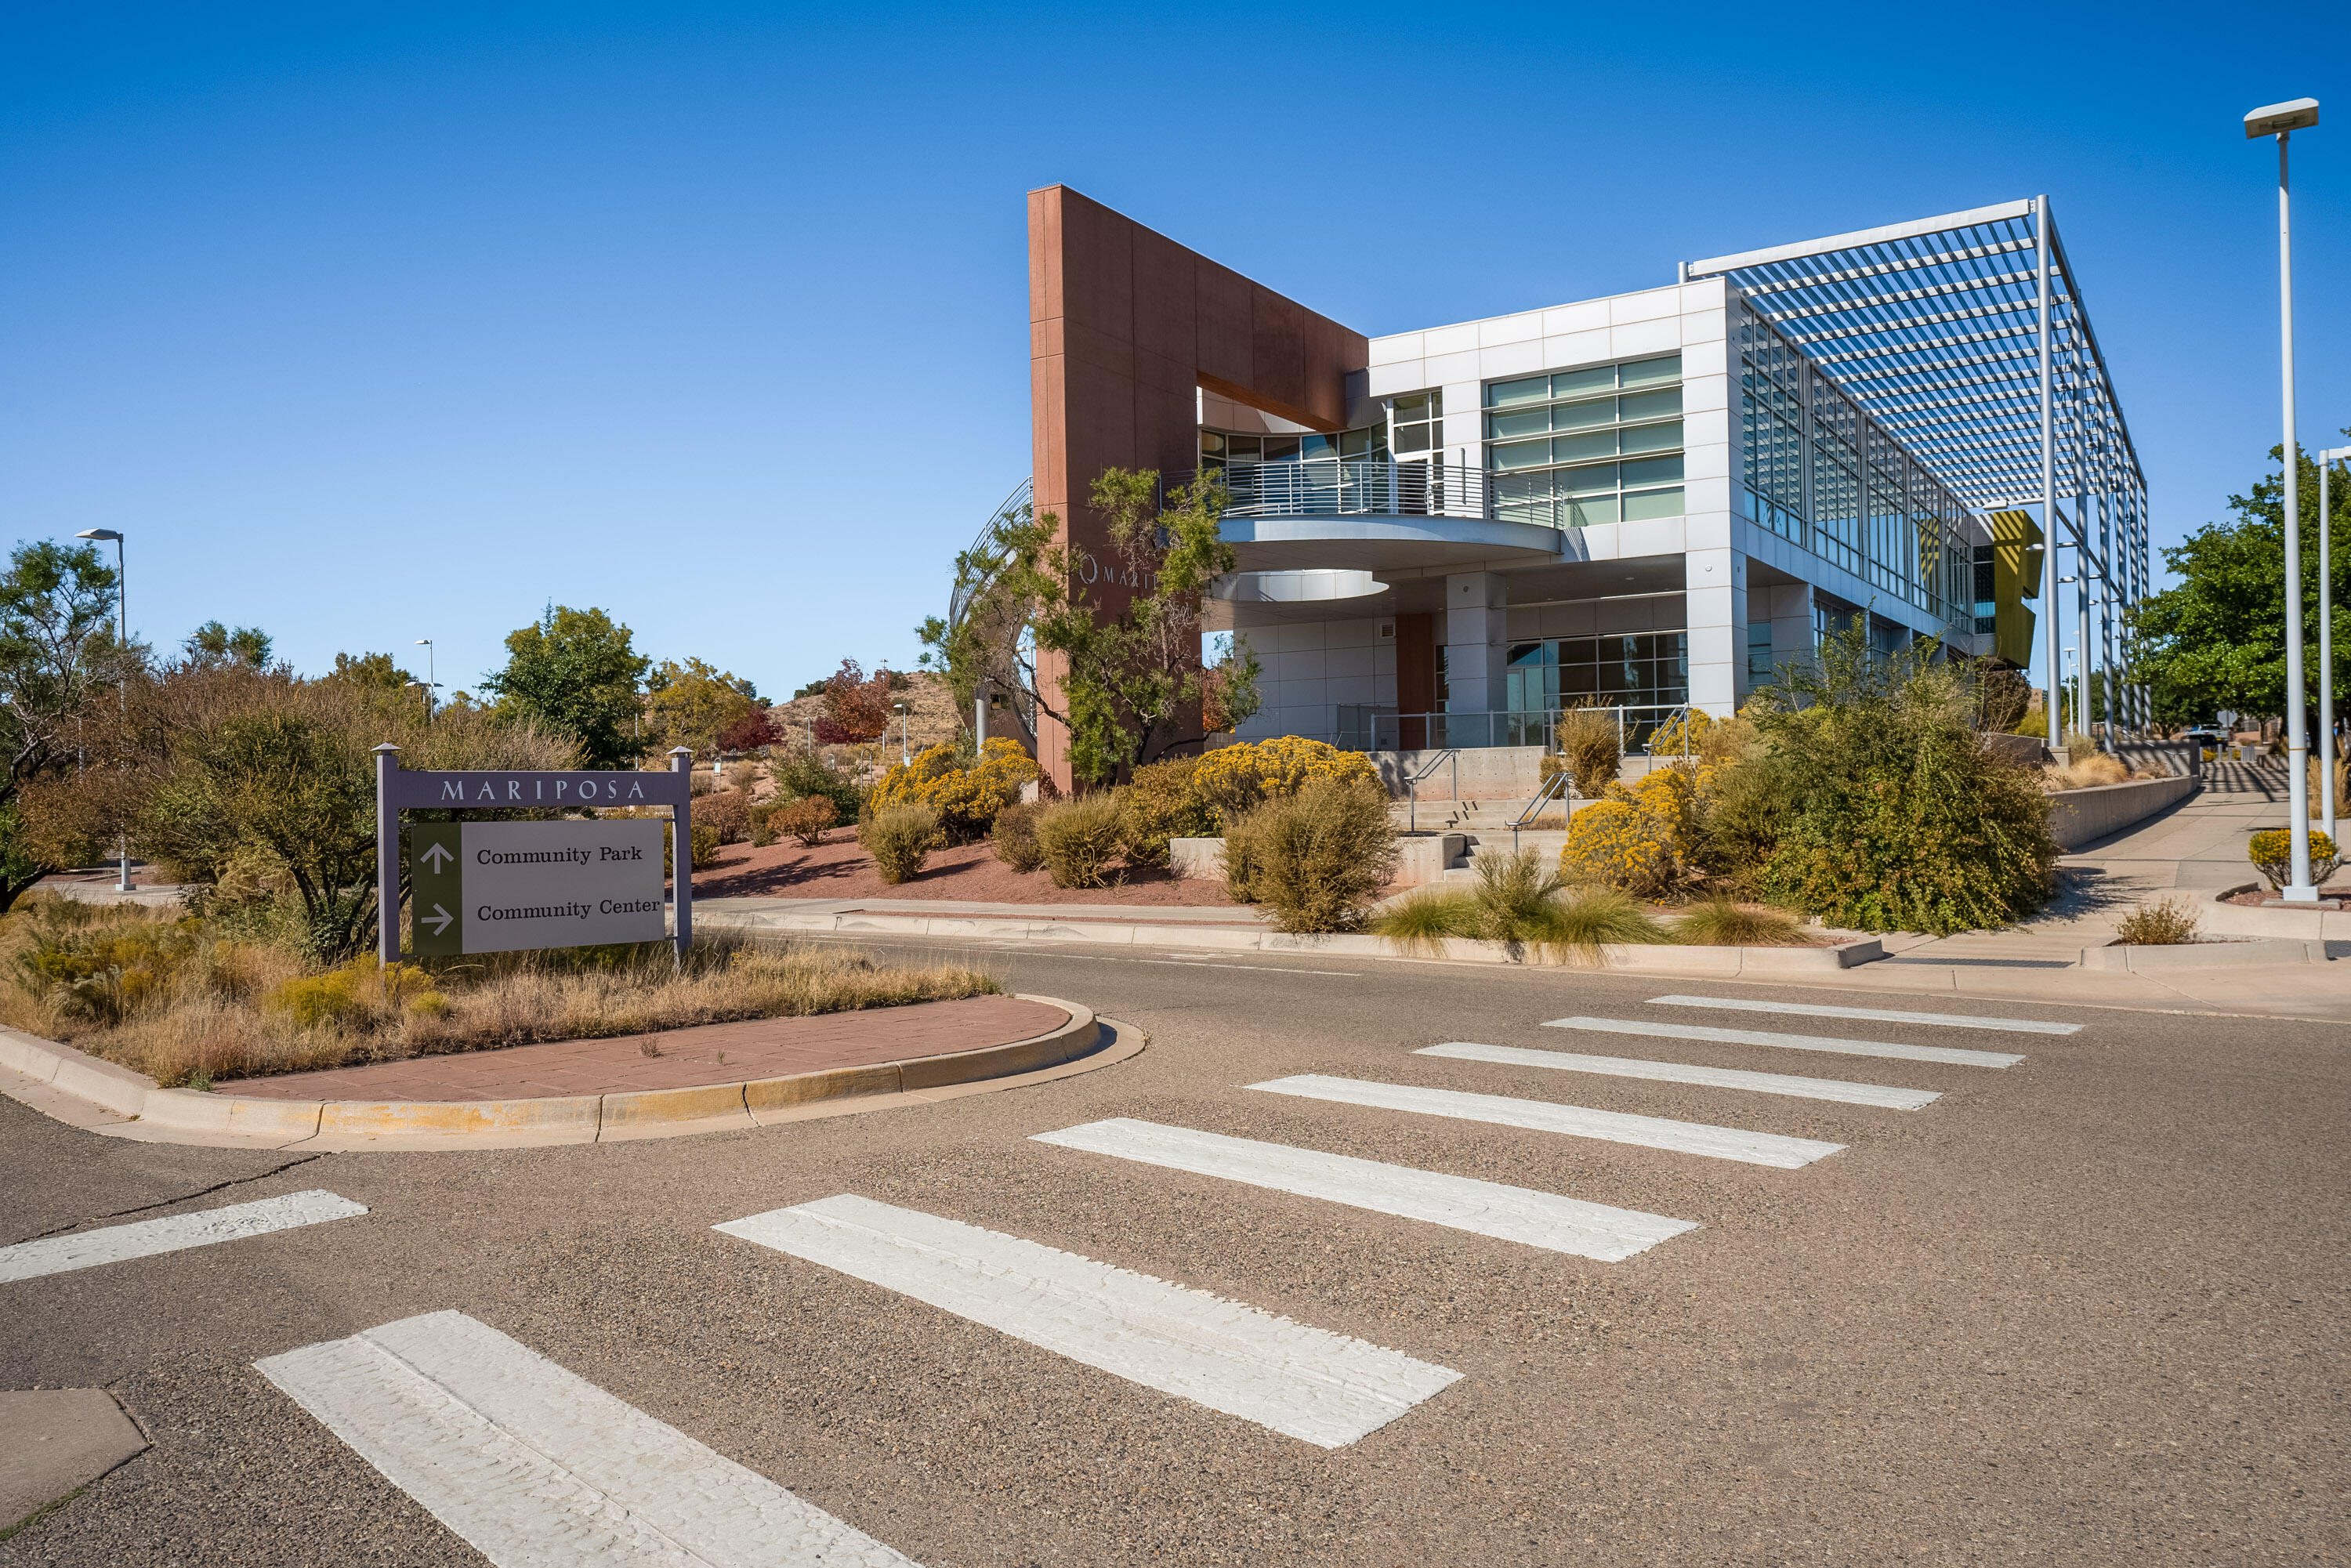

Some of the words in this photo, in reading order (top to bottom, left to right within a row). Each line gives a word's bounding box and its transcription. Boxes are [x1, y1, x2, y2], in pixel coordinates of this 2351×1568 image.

[441, 780, 644, 800] MARIPOSA
[476, 847, 592, 865] Community
[599, 846, 643, 860] Park
[477, 901, 592, 921] Community
[599, 899, 660, 914] Center
